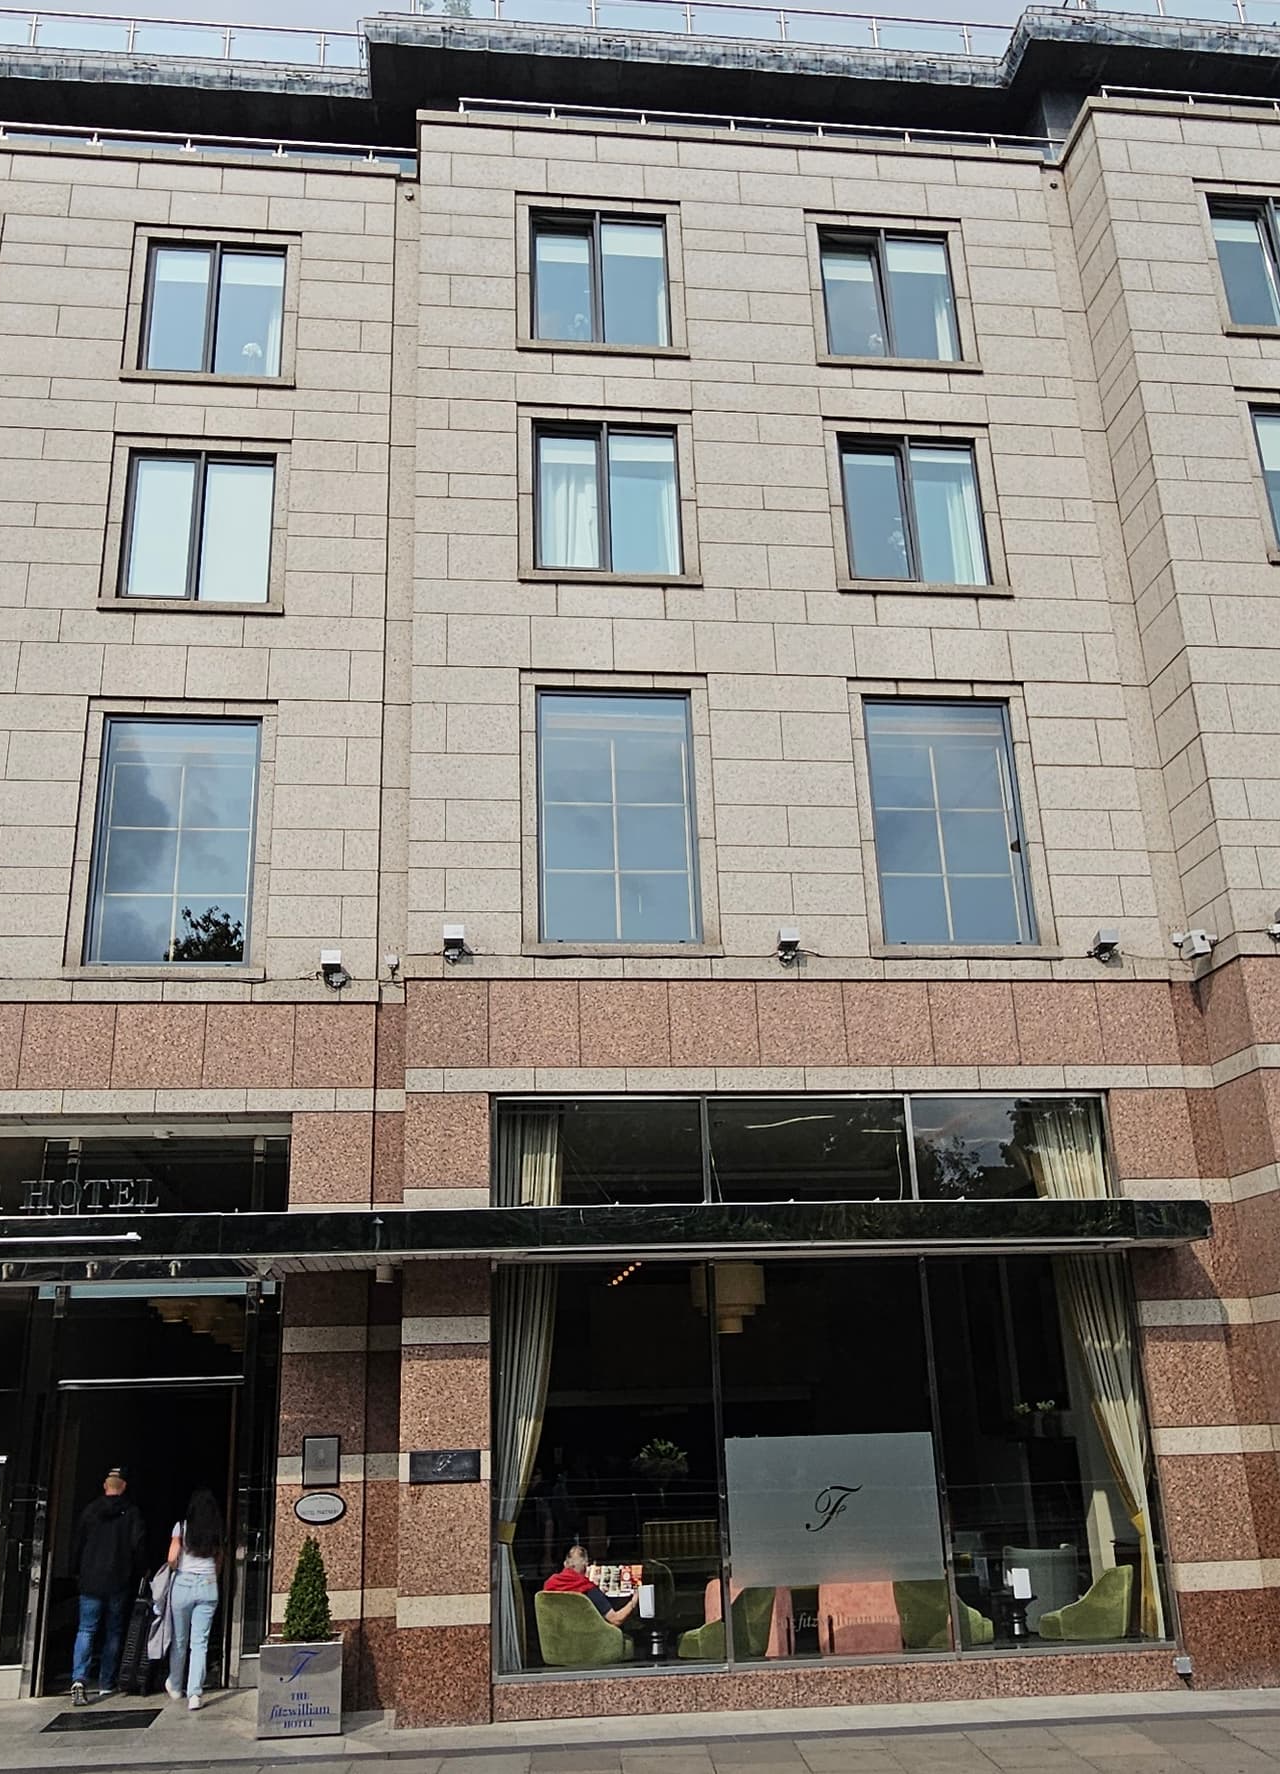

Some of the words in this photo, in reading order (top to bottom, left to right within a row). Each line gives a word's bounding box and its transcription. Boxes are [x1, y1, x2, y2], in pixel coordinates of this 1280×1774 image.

[19, 1178, 160, 1209] HOTEL
[291, 1692, 308, 1701] THE
[270, 1703, 330, 1720] fitzwilliam
[283, 1719, 313, 1729] HOTEL
